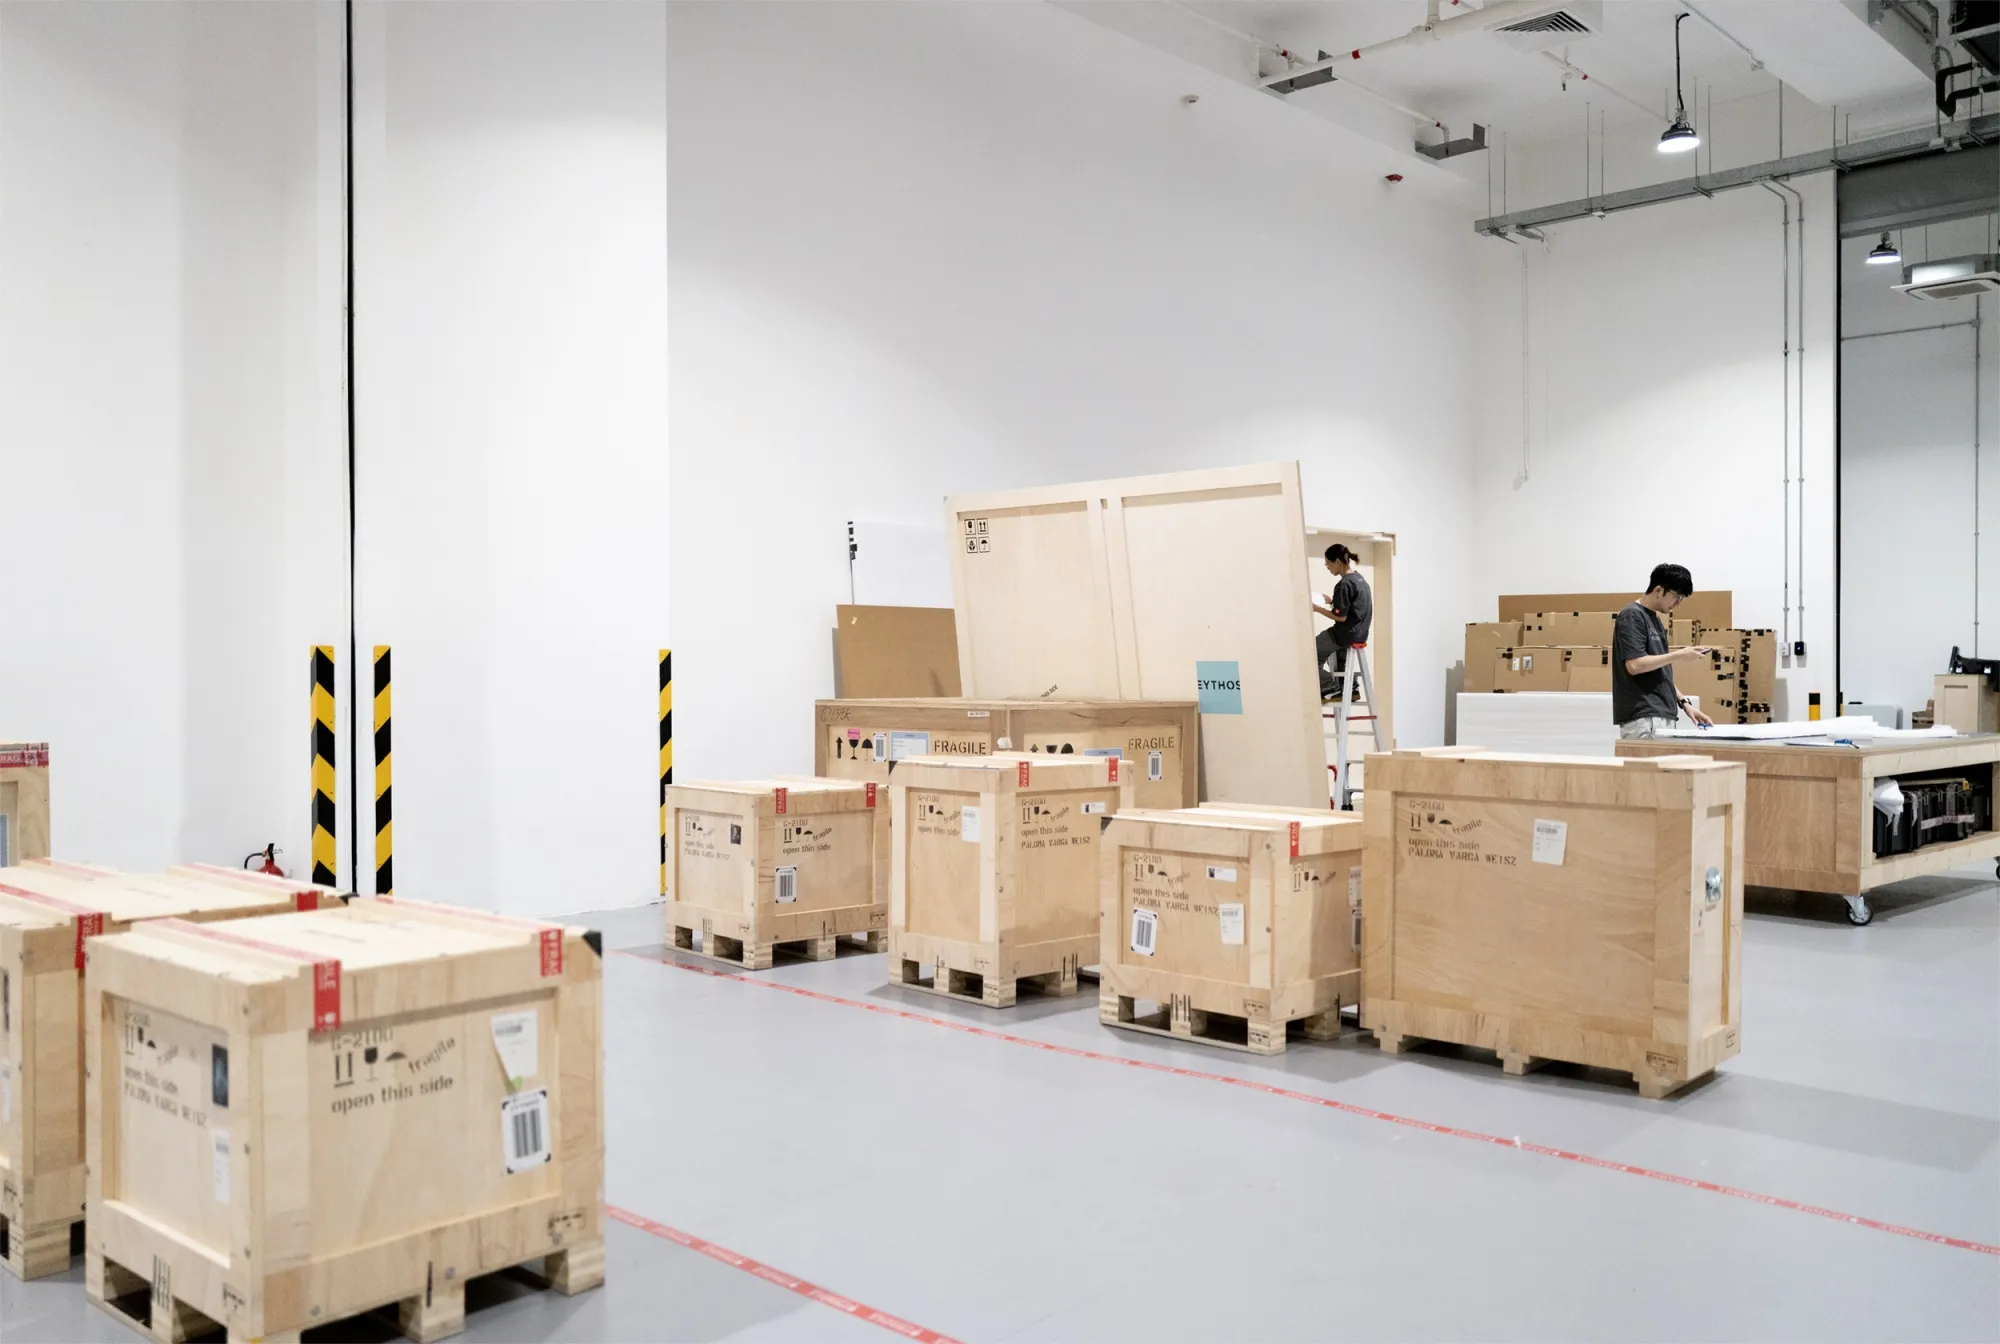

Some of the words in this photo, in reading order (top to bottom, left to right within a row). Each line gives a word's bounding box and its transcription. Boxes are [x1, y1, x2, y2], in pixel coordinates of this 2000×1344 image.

[934, 740, 987, 755] FRAGILE
[1128, 736, 1175, 751] FRAGILE
[1021, 828, 1038, 838] open
[1039, 826, 1053, 835] this
[1054, 825, 1069, 834] side
[1071, 836, 1091, 845] WEISZ
[782, 846, 800, 856] open
[1408, 848, 1444, 860] PALOMA
[1450, 850, 1480, 862] VARGA
[1485, 854, 1517, 866] WEISZ
[1133, 897, 1161, 908] PALOMA
[407, 1036, 457, 1075] fragile
[331, 1092, 375, 1115] open
[381, 1083, 413, 1104] this
[420, 1074, 454, 1095] side
